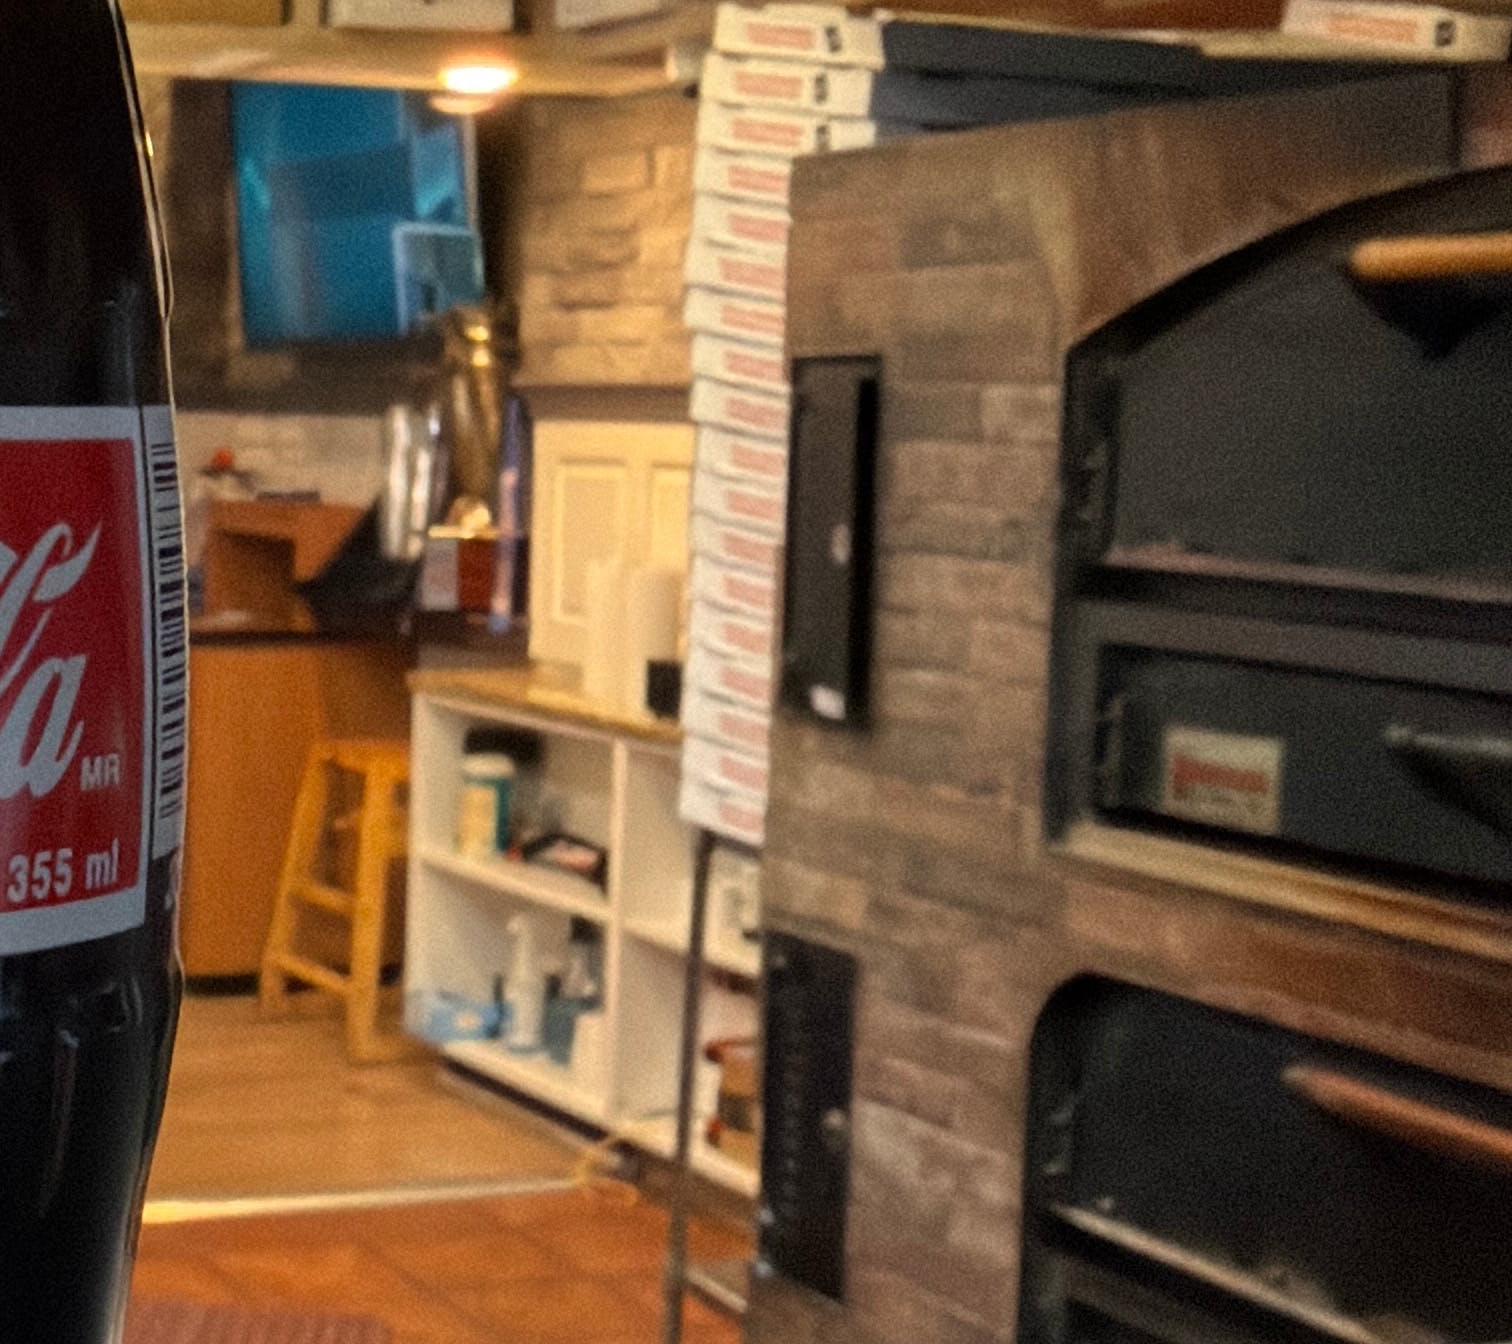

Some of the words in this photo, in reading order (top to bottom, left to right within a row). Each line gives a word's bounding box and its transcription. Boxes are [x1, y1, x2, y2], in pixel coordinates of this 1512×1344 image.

[80, 753, 121, 791] MR
[6, 848, 73, 903] 355
[85, 838, 120, 890] ml
